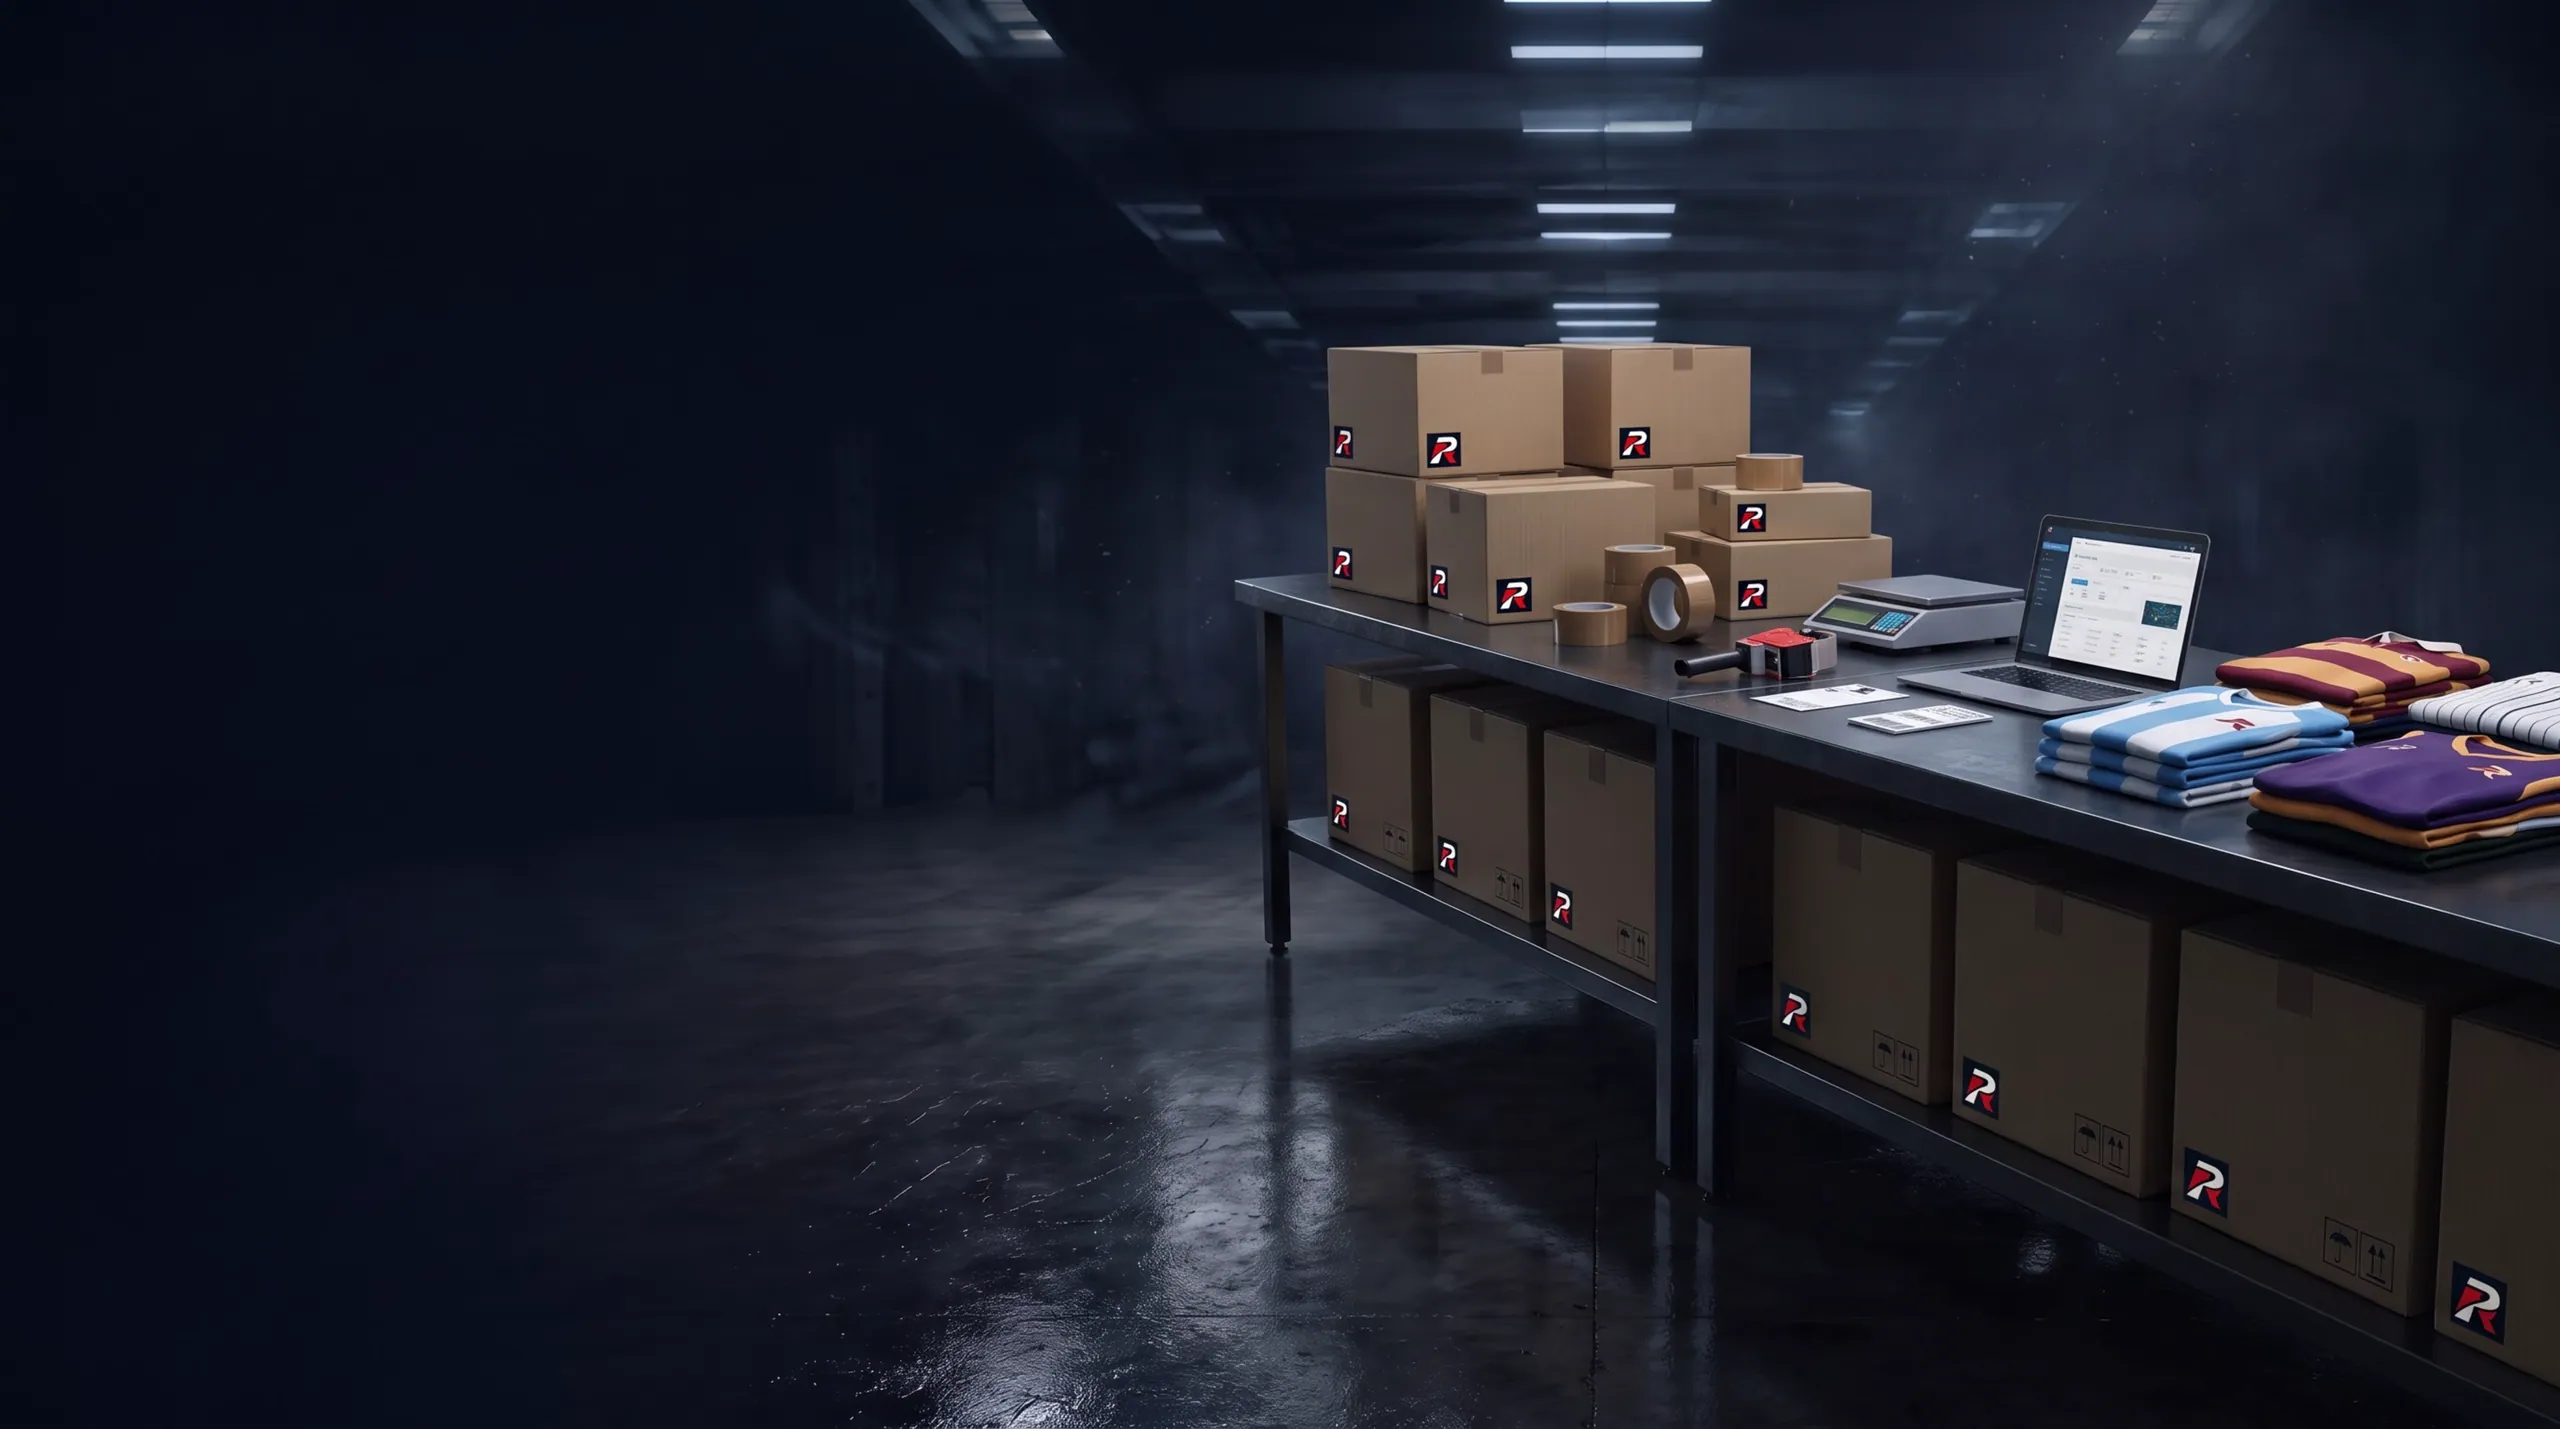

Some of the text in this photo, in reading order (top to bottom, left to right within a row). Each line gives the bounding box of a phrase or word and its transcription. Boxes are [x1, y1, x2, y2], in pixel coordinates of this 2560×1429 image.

[1335, 430, 1352, 456] R
[1430, 436, 1458, 465] R
[1622, 430, 1648, 456] R
[1739, 506, 1764, 530] R
[1334, 550, 1351, 577] R
[1432, 569, 1446, 596] R
[1500, 581, 1529, 610] R
[1740, 583, 1765, 608] R
[1333, 799, 1348, 828] R
[1440, 842, 1456, 873] R
[1553, 890, 1570, 924] R
[1782, 992, 1808, 1032] R
[1964, 1068, 1996, 1113] R
[2186, 1159, 2224, 1210] R
[2454, 1277, 2500, 1334] R
